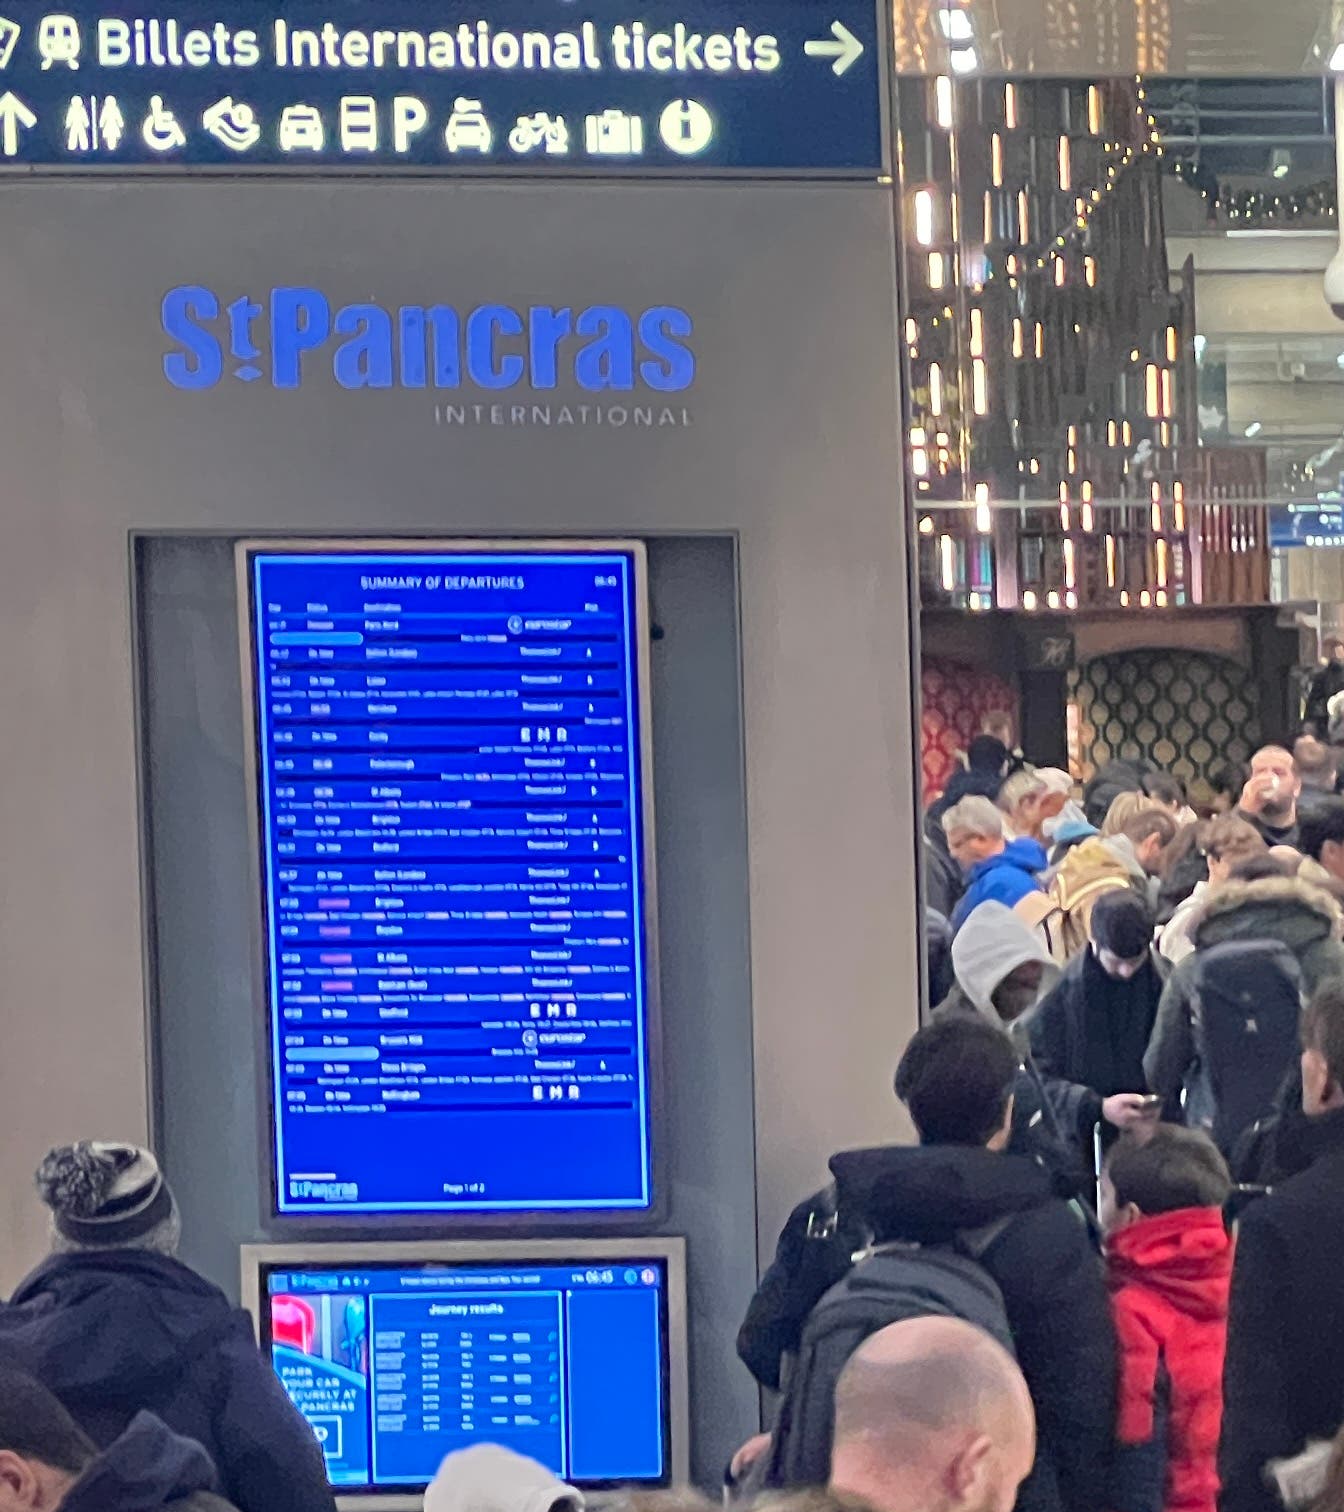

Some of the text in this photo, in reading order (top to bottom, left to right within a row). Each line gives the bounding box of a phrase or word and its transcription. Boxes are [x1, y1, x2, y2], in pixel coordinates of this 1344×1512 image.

[97, 17, 781, 72] Billets International tickets
[434, 403, 696, 428] INTERNATIONAL
[360, 575, 525, 590] SUMMARY OF DEPARTURES
